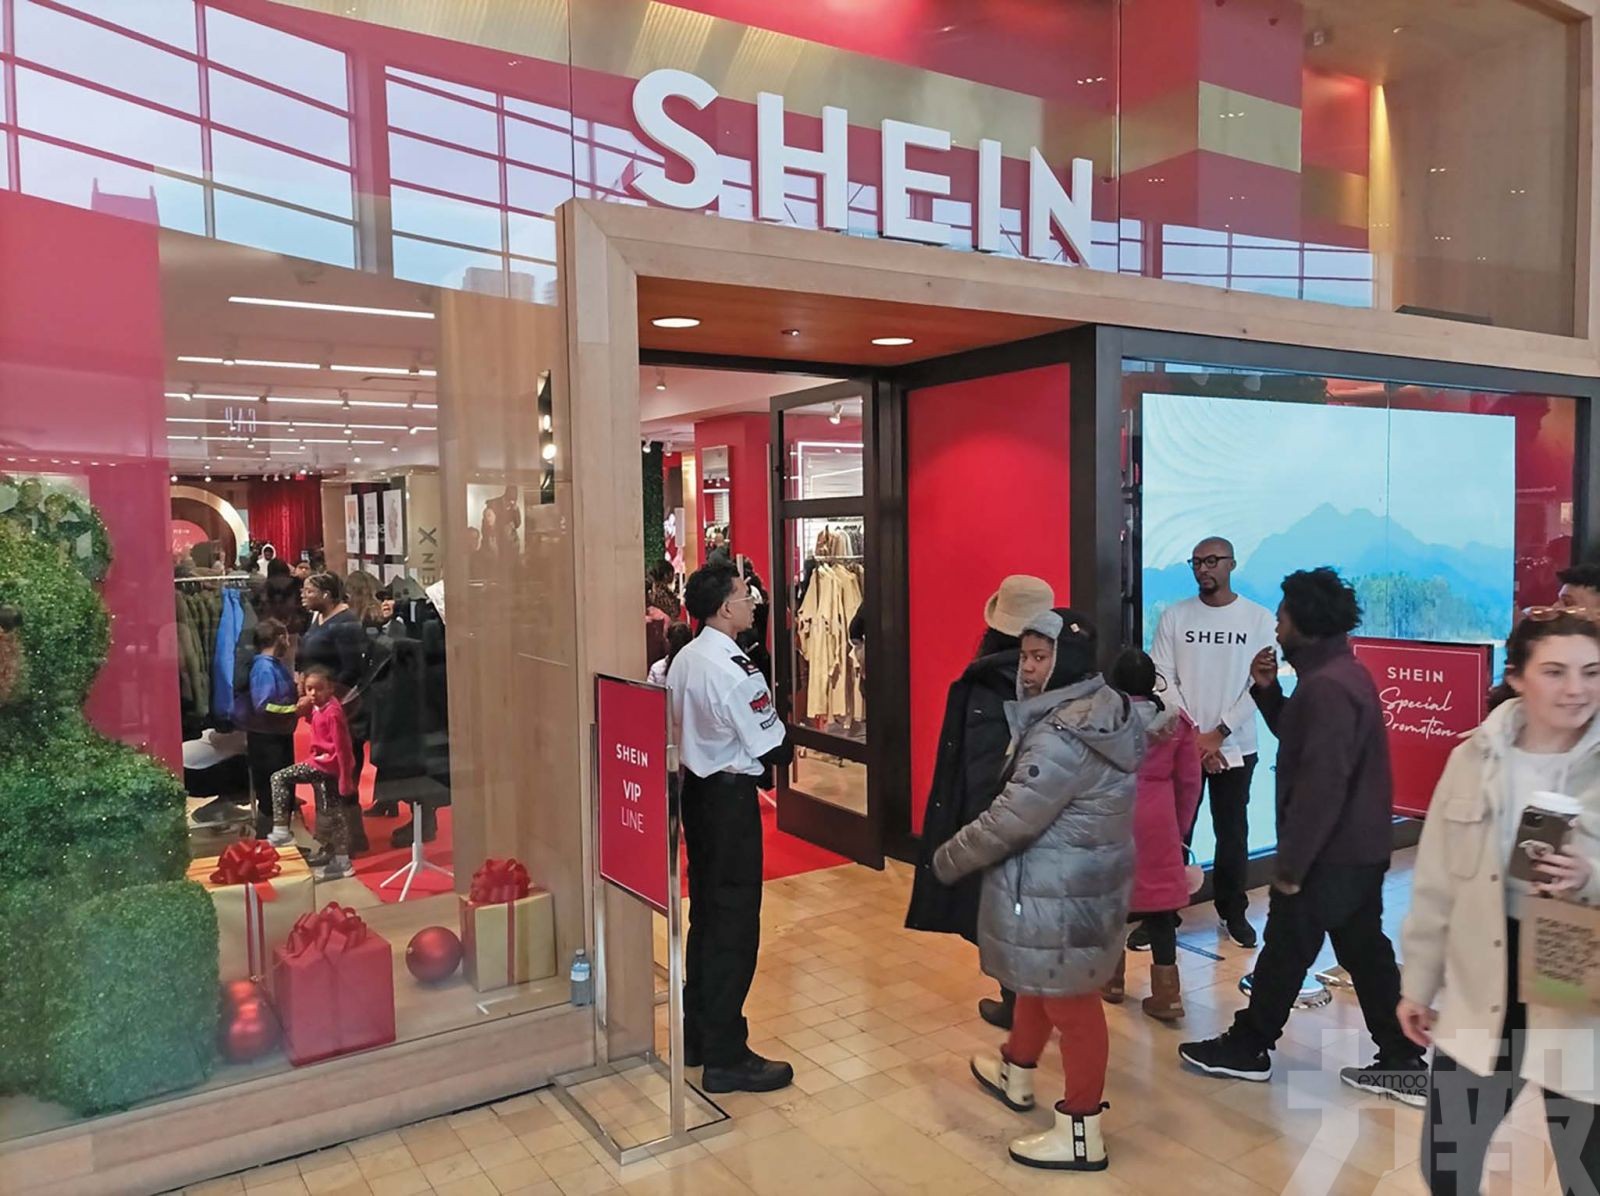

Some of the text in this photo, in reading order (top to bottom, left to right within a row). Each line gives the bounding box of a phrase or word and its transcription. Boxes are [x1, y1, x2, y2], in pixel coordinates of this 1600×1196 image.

[632, 68, 1094, 268] SHEIN
[418, 526, 439, 587] EIN X
[1184, 630, 1248, 646] SHEIN
[1386, 666, 1444, 683] SHEIN
[1378, 686, 1453, 715] Special
[616, 743, 648, 769] SHEIN
[622, 779, 642, 803] VIP
[621, 806, 645, 834] LINE
